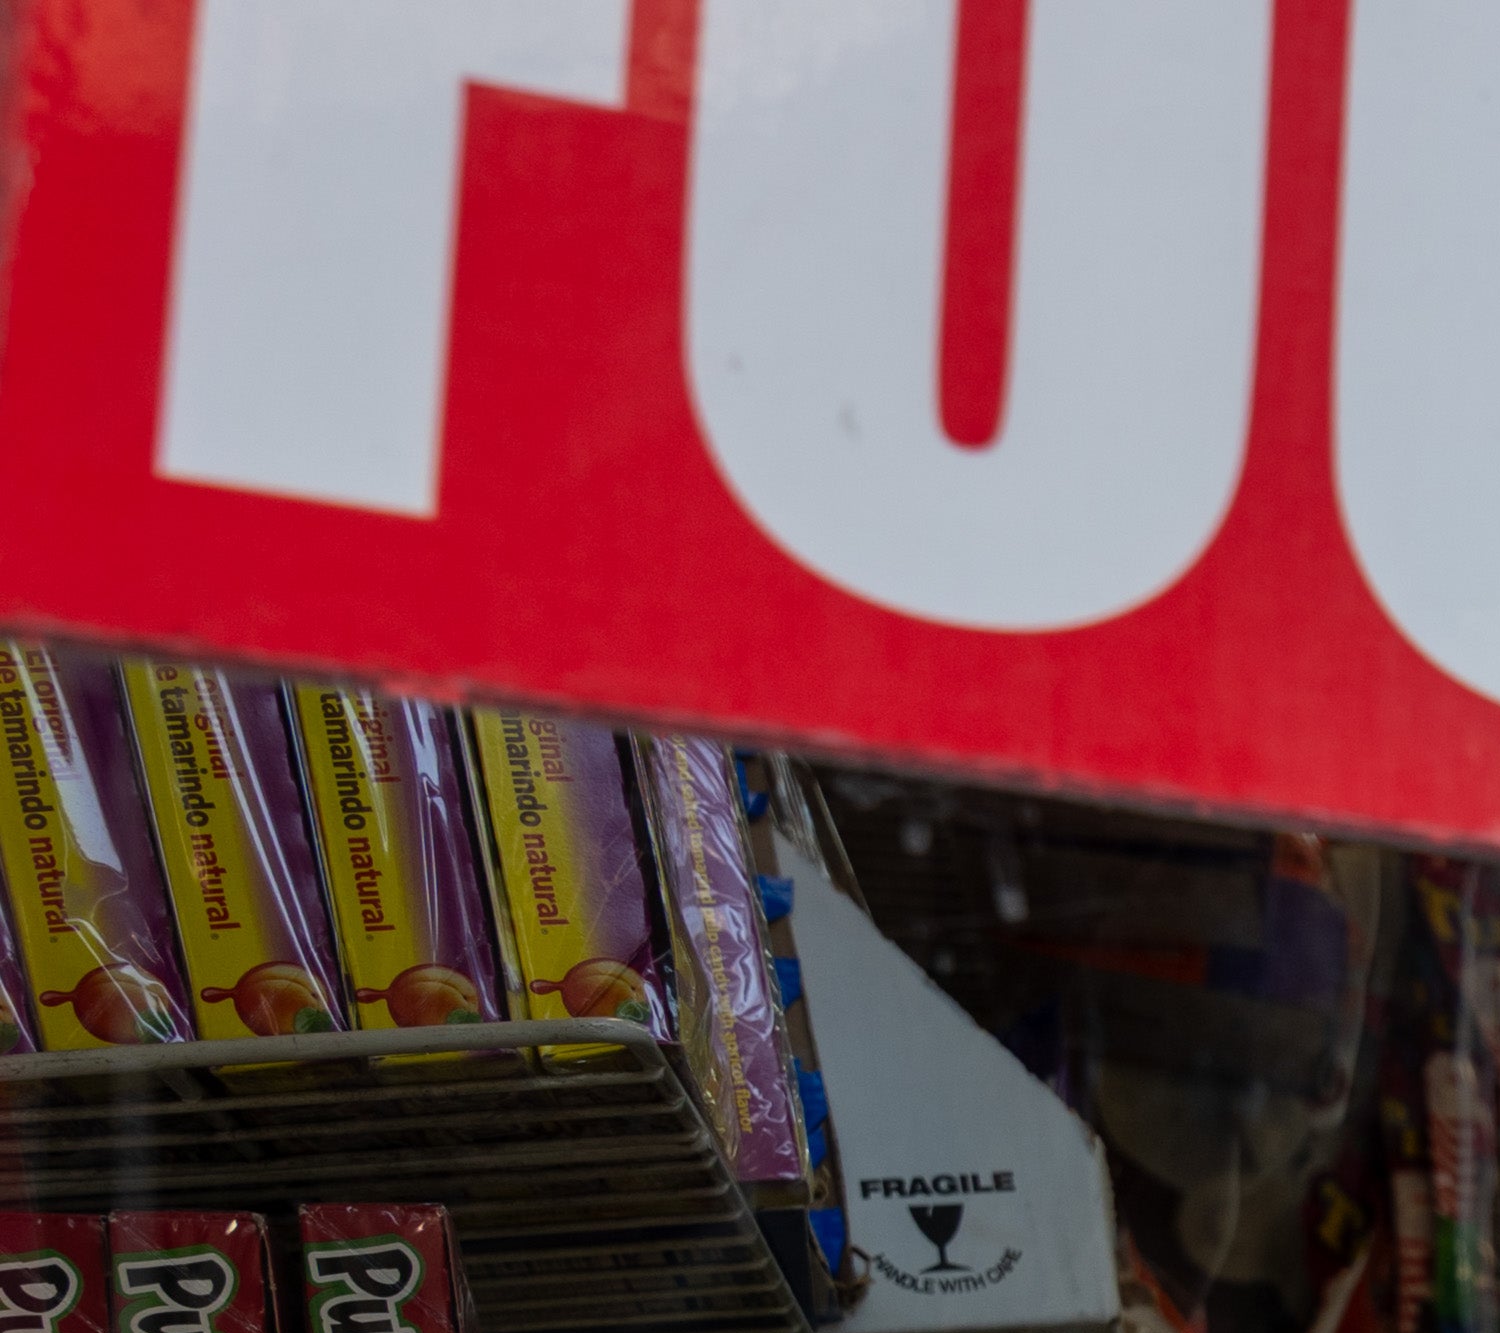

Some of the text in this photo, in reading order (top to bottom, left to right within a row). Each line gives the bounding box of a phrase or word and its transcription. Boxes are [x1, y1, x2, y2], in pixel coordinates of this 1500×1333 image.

[1, 689, 55, 831] tamarindo
[28, 836, 80, 934] natural
[160, 686, 216, 828] tamarindo
[191, 833, 242, 931] natural
[320, 692, 373, 831] tamarindo
[347, 836, 397, 932] natural
[499, 708, 549, 828] amarindo
[523, 832, 570, 927] natural
[734, 1087, 753, 1134] flavor
[860, 1170, 1016, 1200] FRAGILE
[871, 1252, 937, 1295] HANDLE
[938, 1275, 987, 1294] WITH
